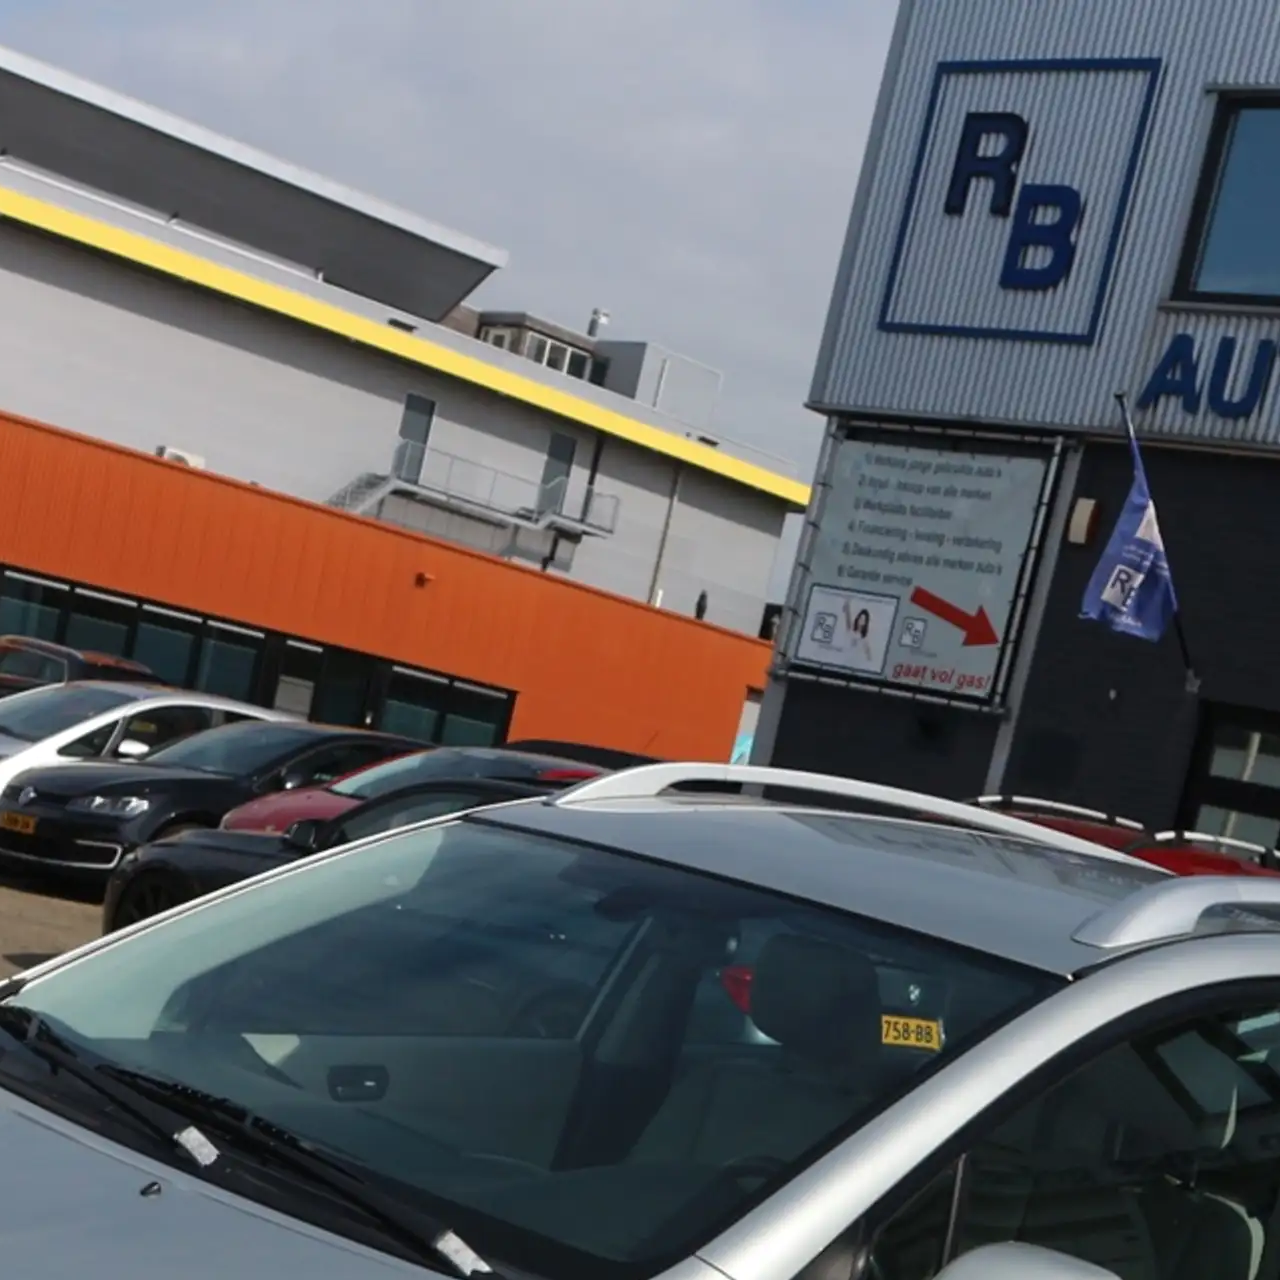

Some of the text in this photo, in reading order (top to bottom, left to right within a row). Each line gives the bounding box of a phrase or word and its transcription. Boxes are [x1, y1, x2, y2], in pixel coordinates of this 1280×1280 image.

[892, 662, 992, 691] gaat vol gas!
[883, 1019, 934, 1044] 758-BB
